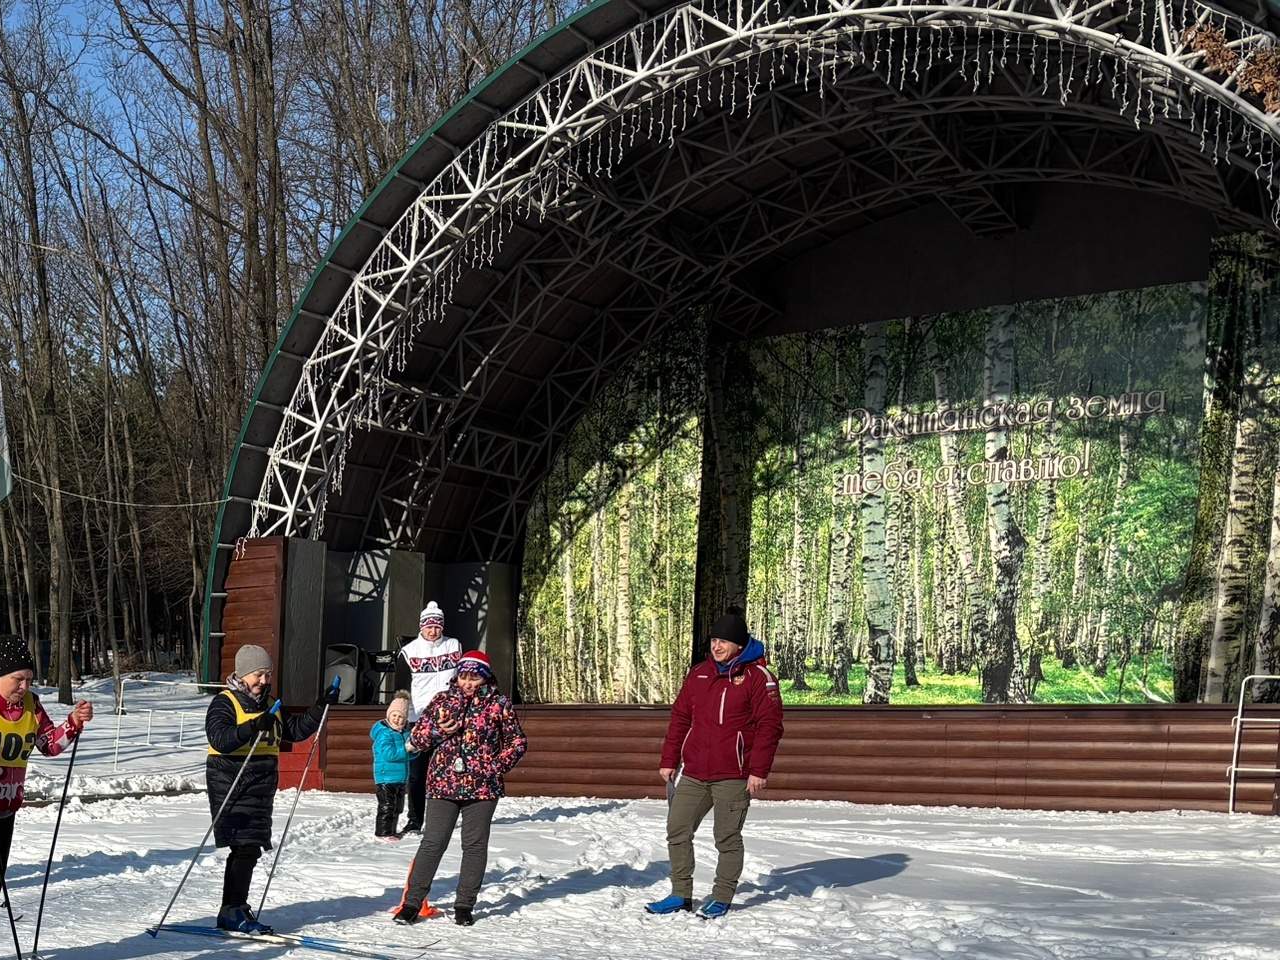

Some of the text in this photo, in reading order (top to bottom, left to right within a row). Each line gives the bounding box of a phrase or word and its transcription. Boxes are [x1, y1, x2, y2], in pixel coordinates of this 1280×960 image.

[845, 396, 1054, 442] Ракитянская
[1065, 387, 1167, 420] земля
[841, 440, 1092, 496] тебя я славлю!
